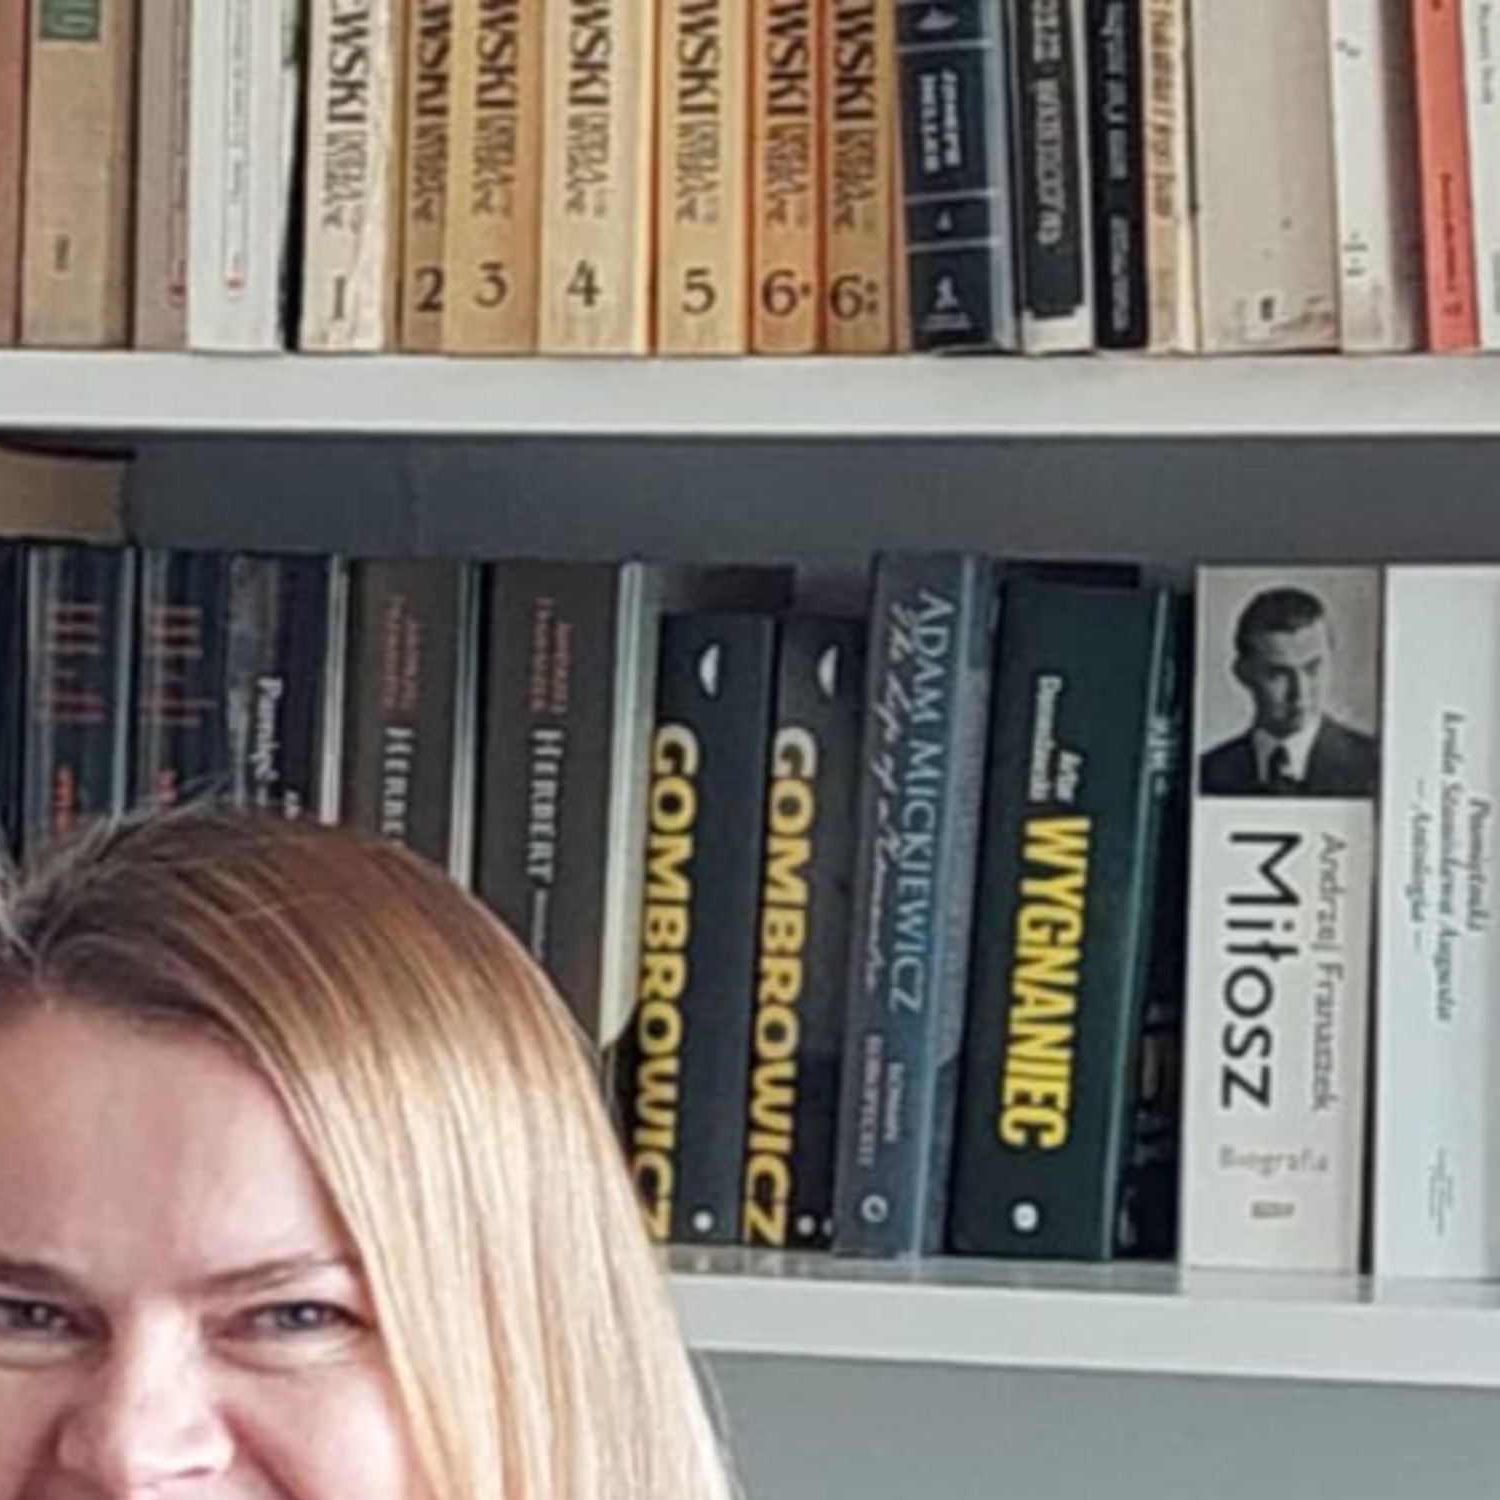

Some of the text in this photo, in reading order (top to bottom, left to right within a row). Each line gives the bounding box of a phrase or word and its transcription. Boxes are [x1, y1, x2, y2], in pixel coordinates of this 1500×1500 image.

[328, 0, 369, 123] WSKI
[415, 0, 451, 121] WSKI
[835, 0, 876, 120] WSKI
[334, 277, 346, 321] 1
[415, 267, 445, 312] 2
[475, 262, 508, 308] 3
[567, 260, 601, 307] 4
[681, 269, 716, 315] 5
[383, 727, 414, 848] HERBE
[528, 728, 564, 883] HERBERT
[888, 590, 956, 1014] ADAM MICKIEWICZ
[745, 726, 818, 1245] GOMBROWICZ
[1000, 816, 1092, 1150] WYGNANIEC
[1221, 831, 1304, 1109] Miłosz
[1312, 831, 1347, 1112] Andrzej Franaszek
